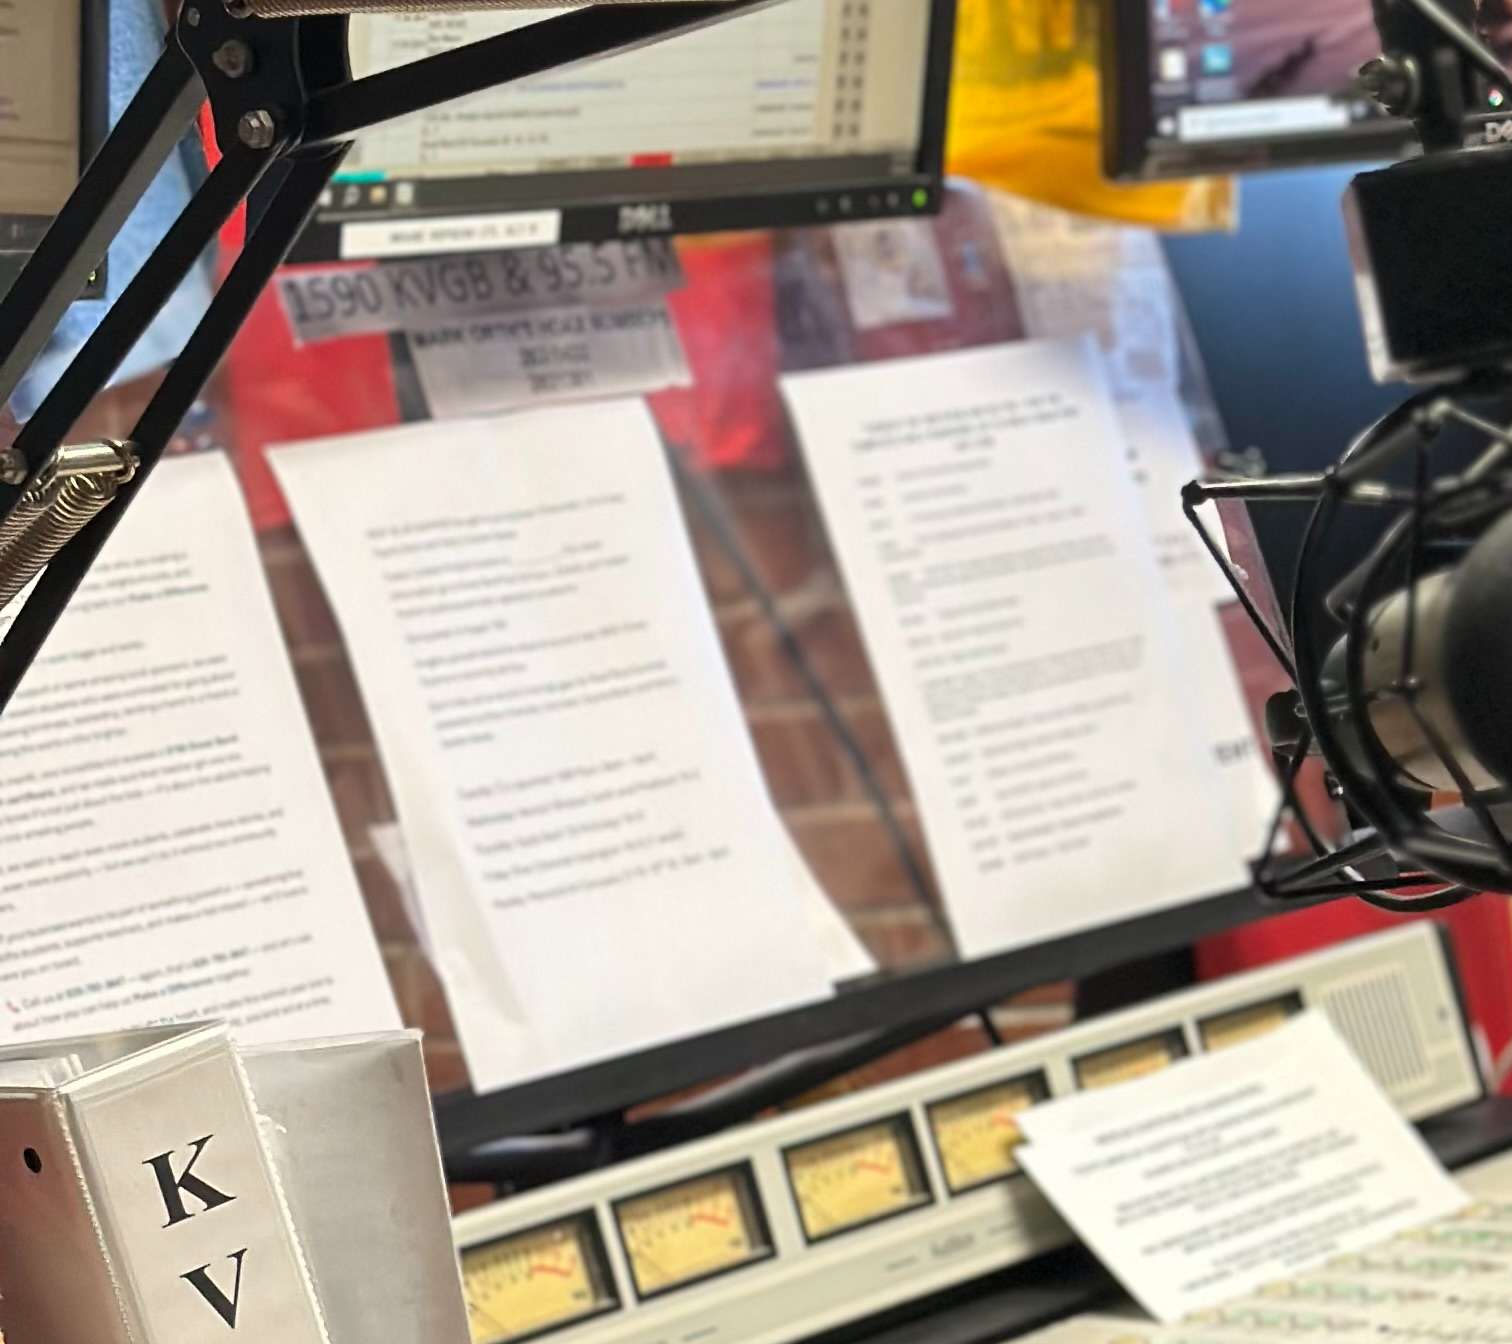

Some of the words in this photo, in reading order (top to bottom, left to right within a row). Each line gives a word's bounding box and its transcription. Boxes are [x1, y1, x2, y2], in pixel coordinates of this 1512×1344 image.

[284, 271, 382, 322] 1590
[391, 255, 493, 310] KVGB
[503, 251, 532, 293] &
[535, 245, 616, 292] 95.5
